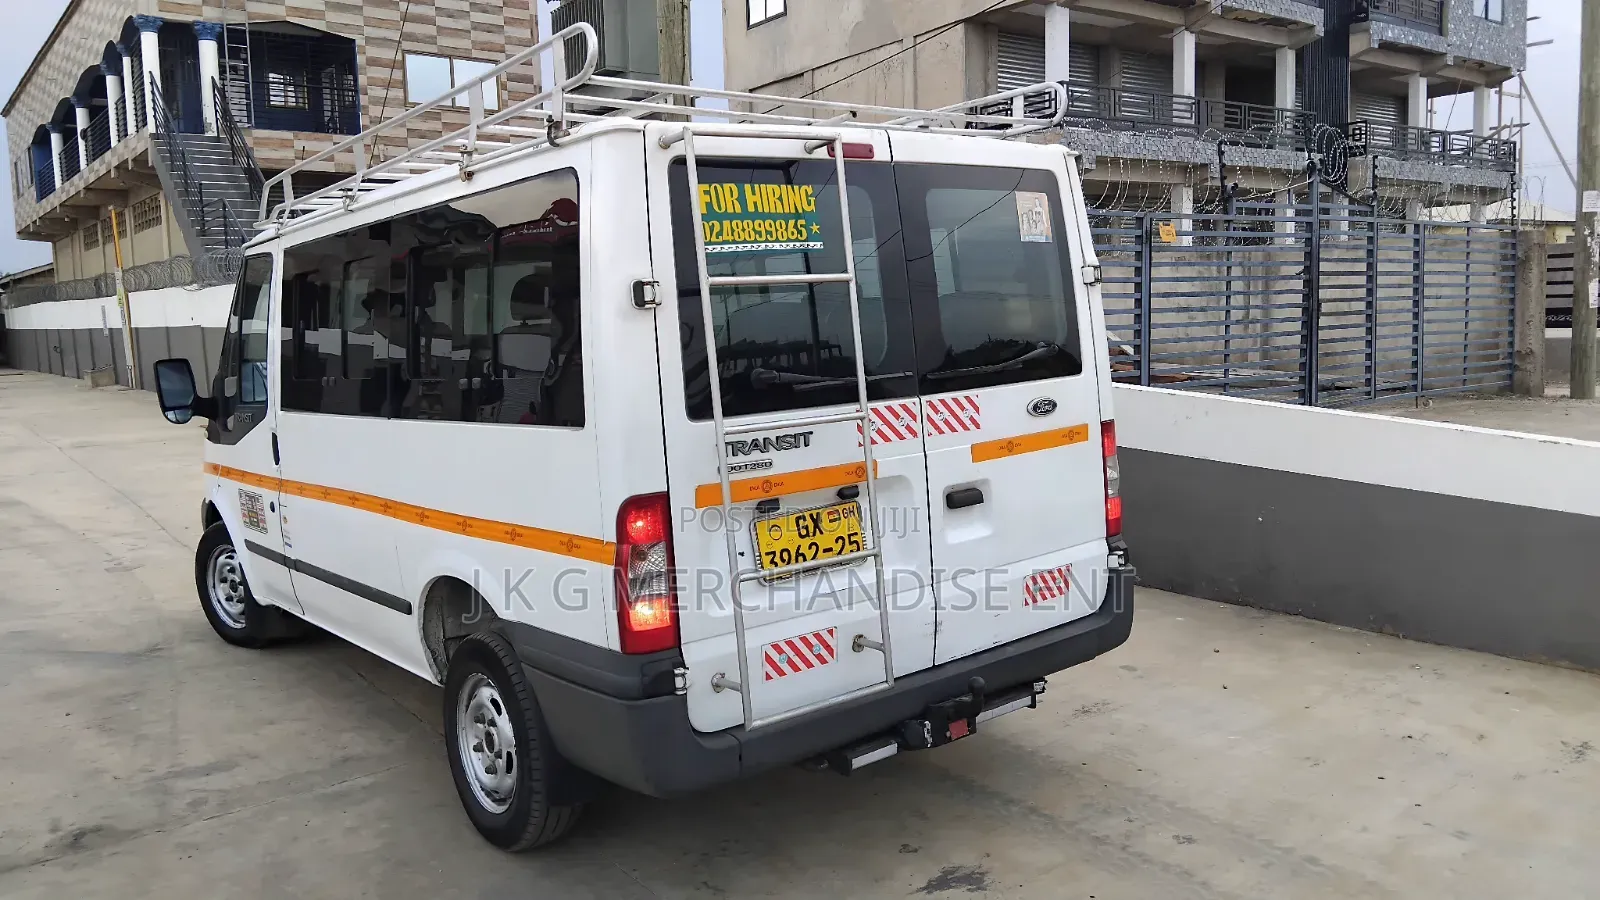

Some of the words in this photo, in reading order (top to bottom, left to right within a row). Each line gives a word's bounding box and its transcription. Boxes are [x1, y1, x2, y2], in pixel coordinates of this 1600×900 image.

[697, 183, 742, 214] FOR
[744, 184, 816, 213] HIRING
[701, 219, 808, 242] 0248899865
[724, 431, 814, 457] TRANSIT
[795, 511, 824, 539] GX
[764, 531, 861, 568] 3962-25
